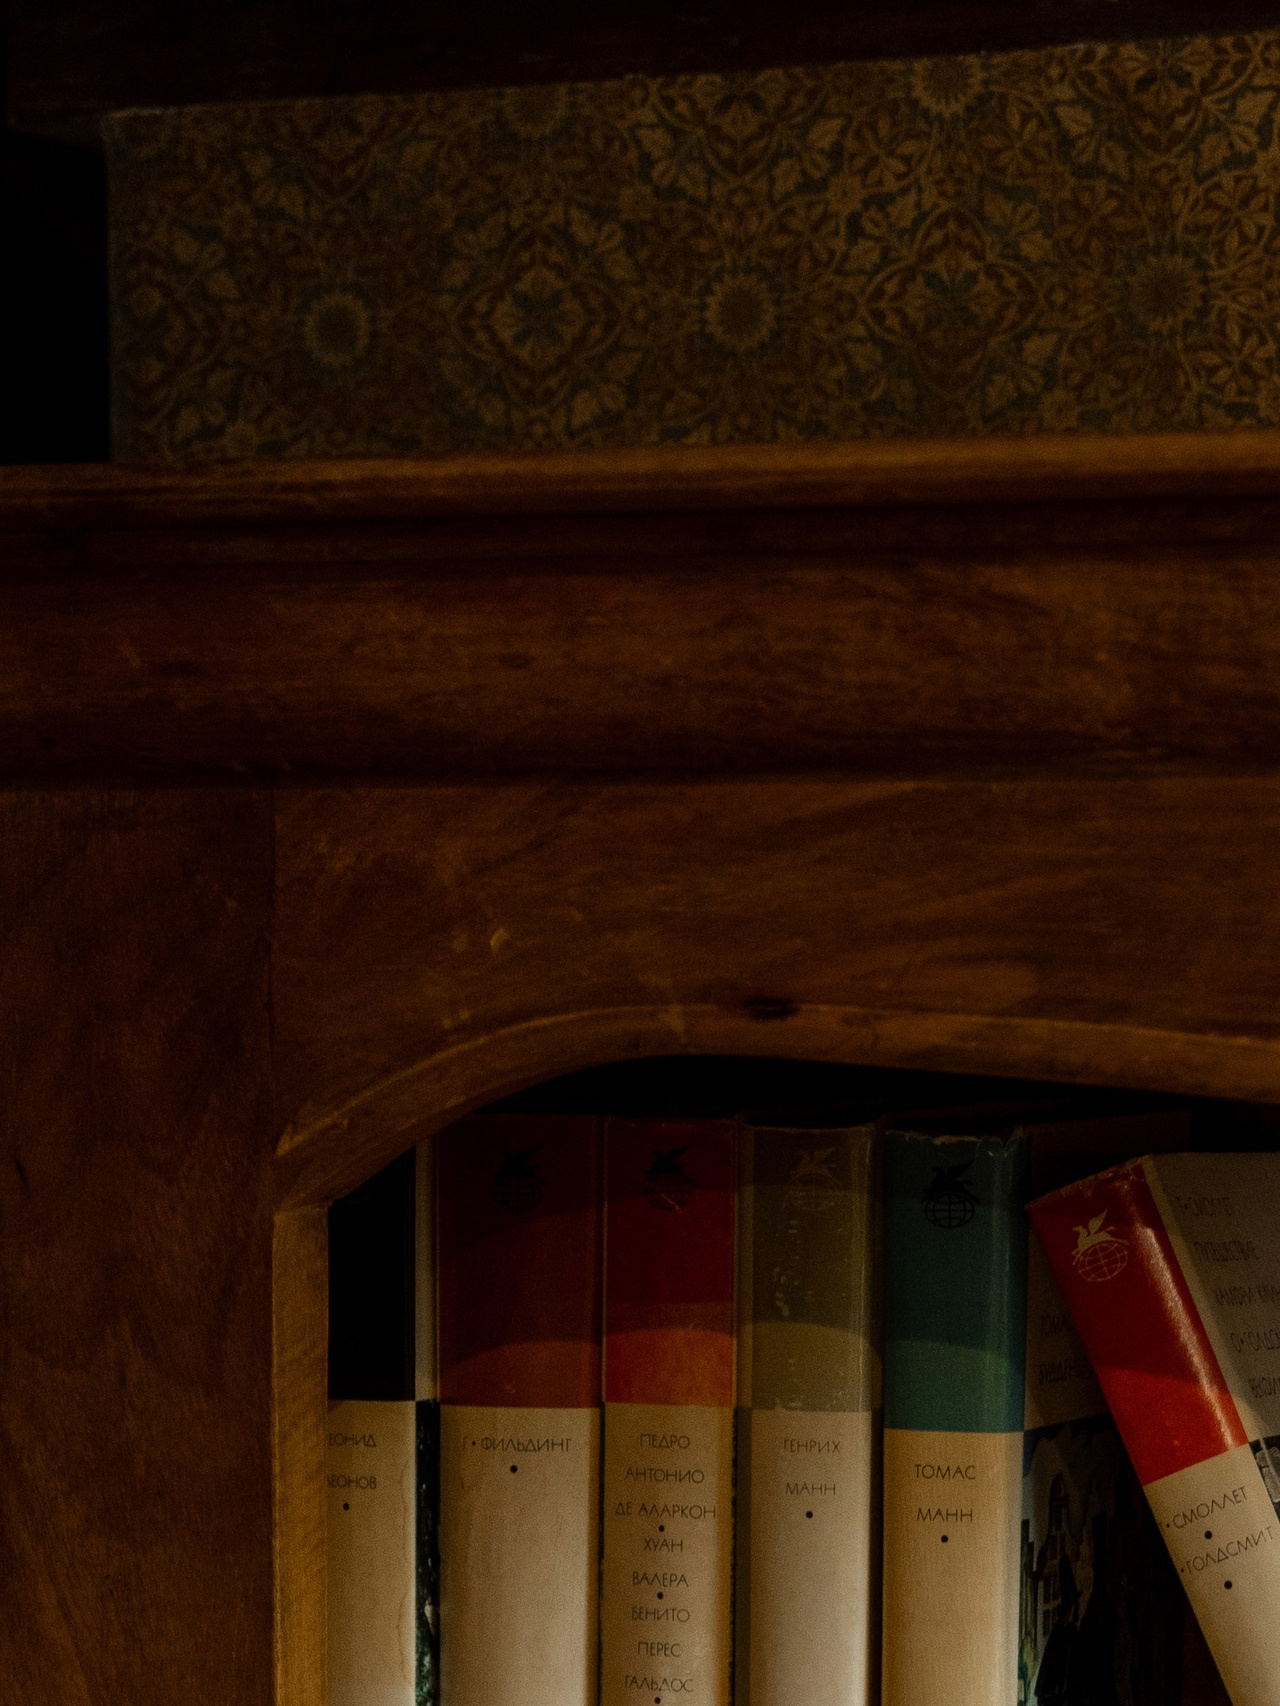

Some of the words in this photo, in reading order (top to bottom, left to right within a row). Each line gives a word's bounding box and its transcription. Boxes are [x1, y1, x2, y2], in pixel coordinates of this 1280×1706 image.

[326, 1432, 377, 1448] ЕОНИД
[480, 1436, 572, 1453] ФИЛЬДИНГ
[639, 1433, 691, 1450] ПЕДРО
[782, 1438, 841, 1453] ГЕНРИХ
[624, 1467, 705, 1484] АНТОНИО
[913, 1463, 976, 1481] ТОМАС
[785, 1481, 837, 1496] МАНН
[614, 1503, 634, 1517] ДЕ
[638, 1503, 717, 1520] АЛАРКОН
[915, 1507, 973, 1523] МАНН
[1171, 1485, 1248, 1530] СМОЛЛЕТ
[643, 1537, 684, 1552] ХУАН
[1185, 1525, 1273, 1575] ГОЛДСМИТ
[632, 1570, 689, 1588] ВАЛЕРА
[631, 1606, 691, 1623] БЕНИТО
[637, 1640, 681, 1658] ПЕРЕС
[624, 1674, 695, 1693] ГАЛЬДОС
